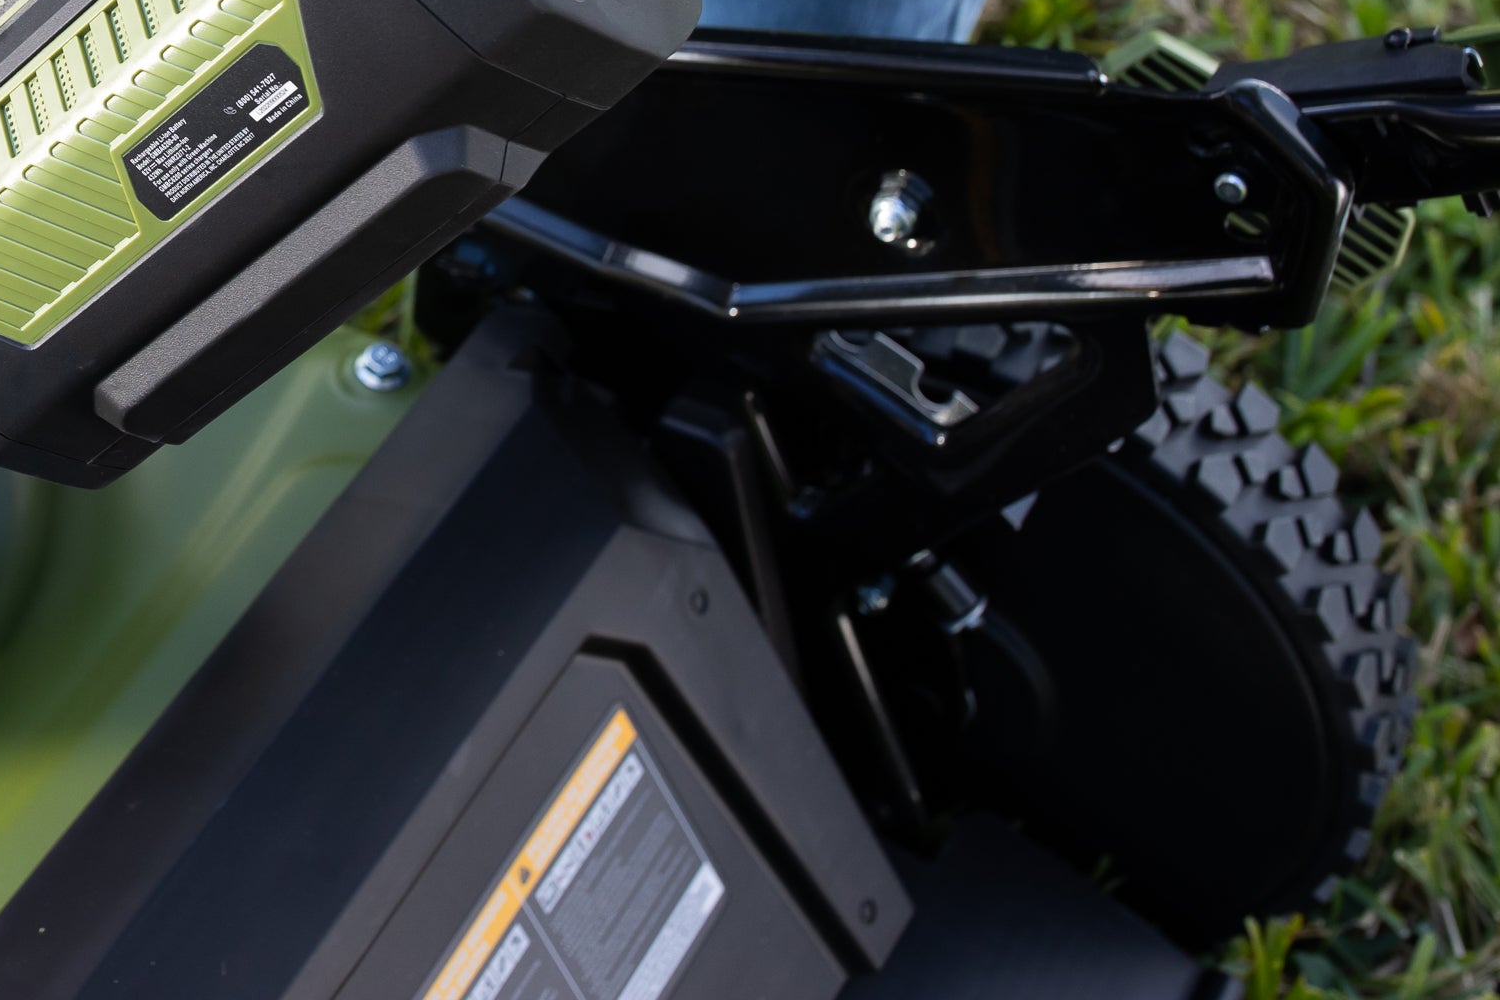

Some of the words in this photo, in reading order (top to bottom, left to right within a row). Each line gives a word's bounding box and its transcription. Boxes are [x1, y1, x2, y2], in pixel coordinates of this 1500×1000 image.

[235, 93, 254, 109] (800)
[249, 72, 276, 97] 541-7027
[253, 89, 272, 105] Serial
[265, 110, 283, 124] Made
[278, 105, 288, 113] in
[285, 93, 303, 108] China
[130, 140, 160, 166] Rechargeable
[168, 118, 187, 133] Battery
[135, 156, 153, 171] Model:
[152, 178, 163, 188] For
[168, 165, 180, 175] only
[177, 157, 189, 168] with
[185, 147, 201, 160] Green
[197, 133, 218, 150] Machine
[154, 155, 167, 165] Max
[164, 181, 184, 198] PRODUCT
[181, 162, 207, 185] DISTRIBUTED
[207, 153, 219, 163] THE
[215, 142, 232, 157] UNITED
[228, 131, 245, 146] STATES
[241, 126, 250, 135] BY
[180, 162, 196, 175] series
[193, 147, 214, 165] chargers
[179, 182, 195, 196] NORTH
